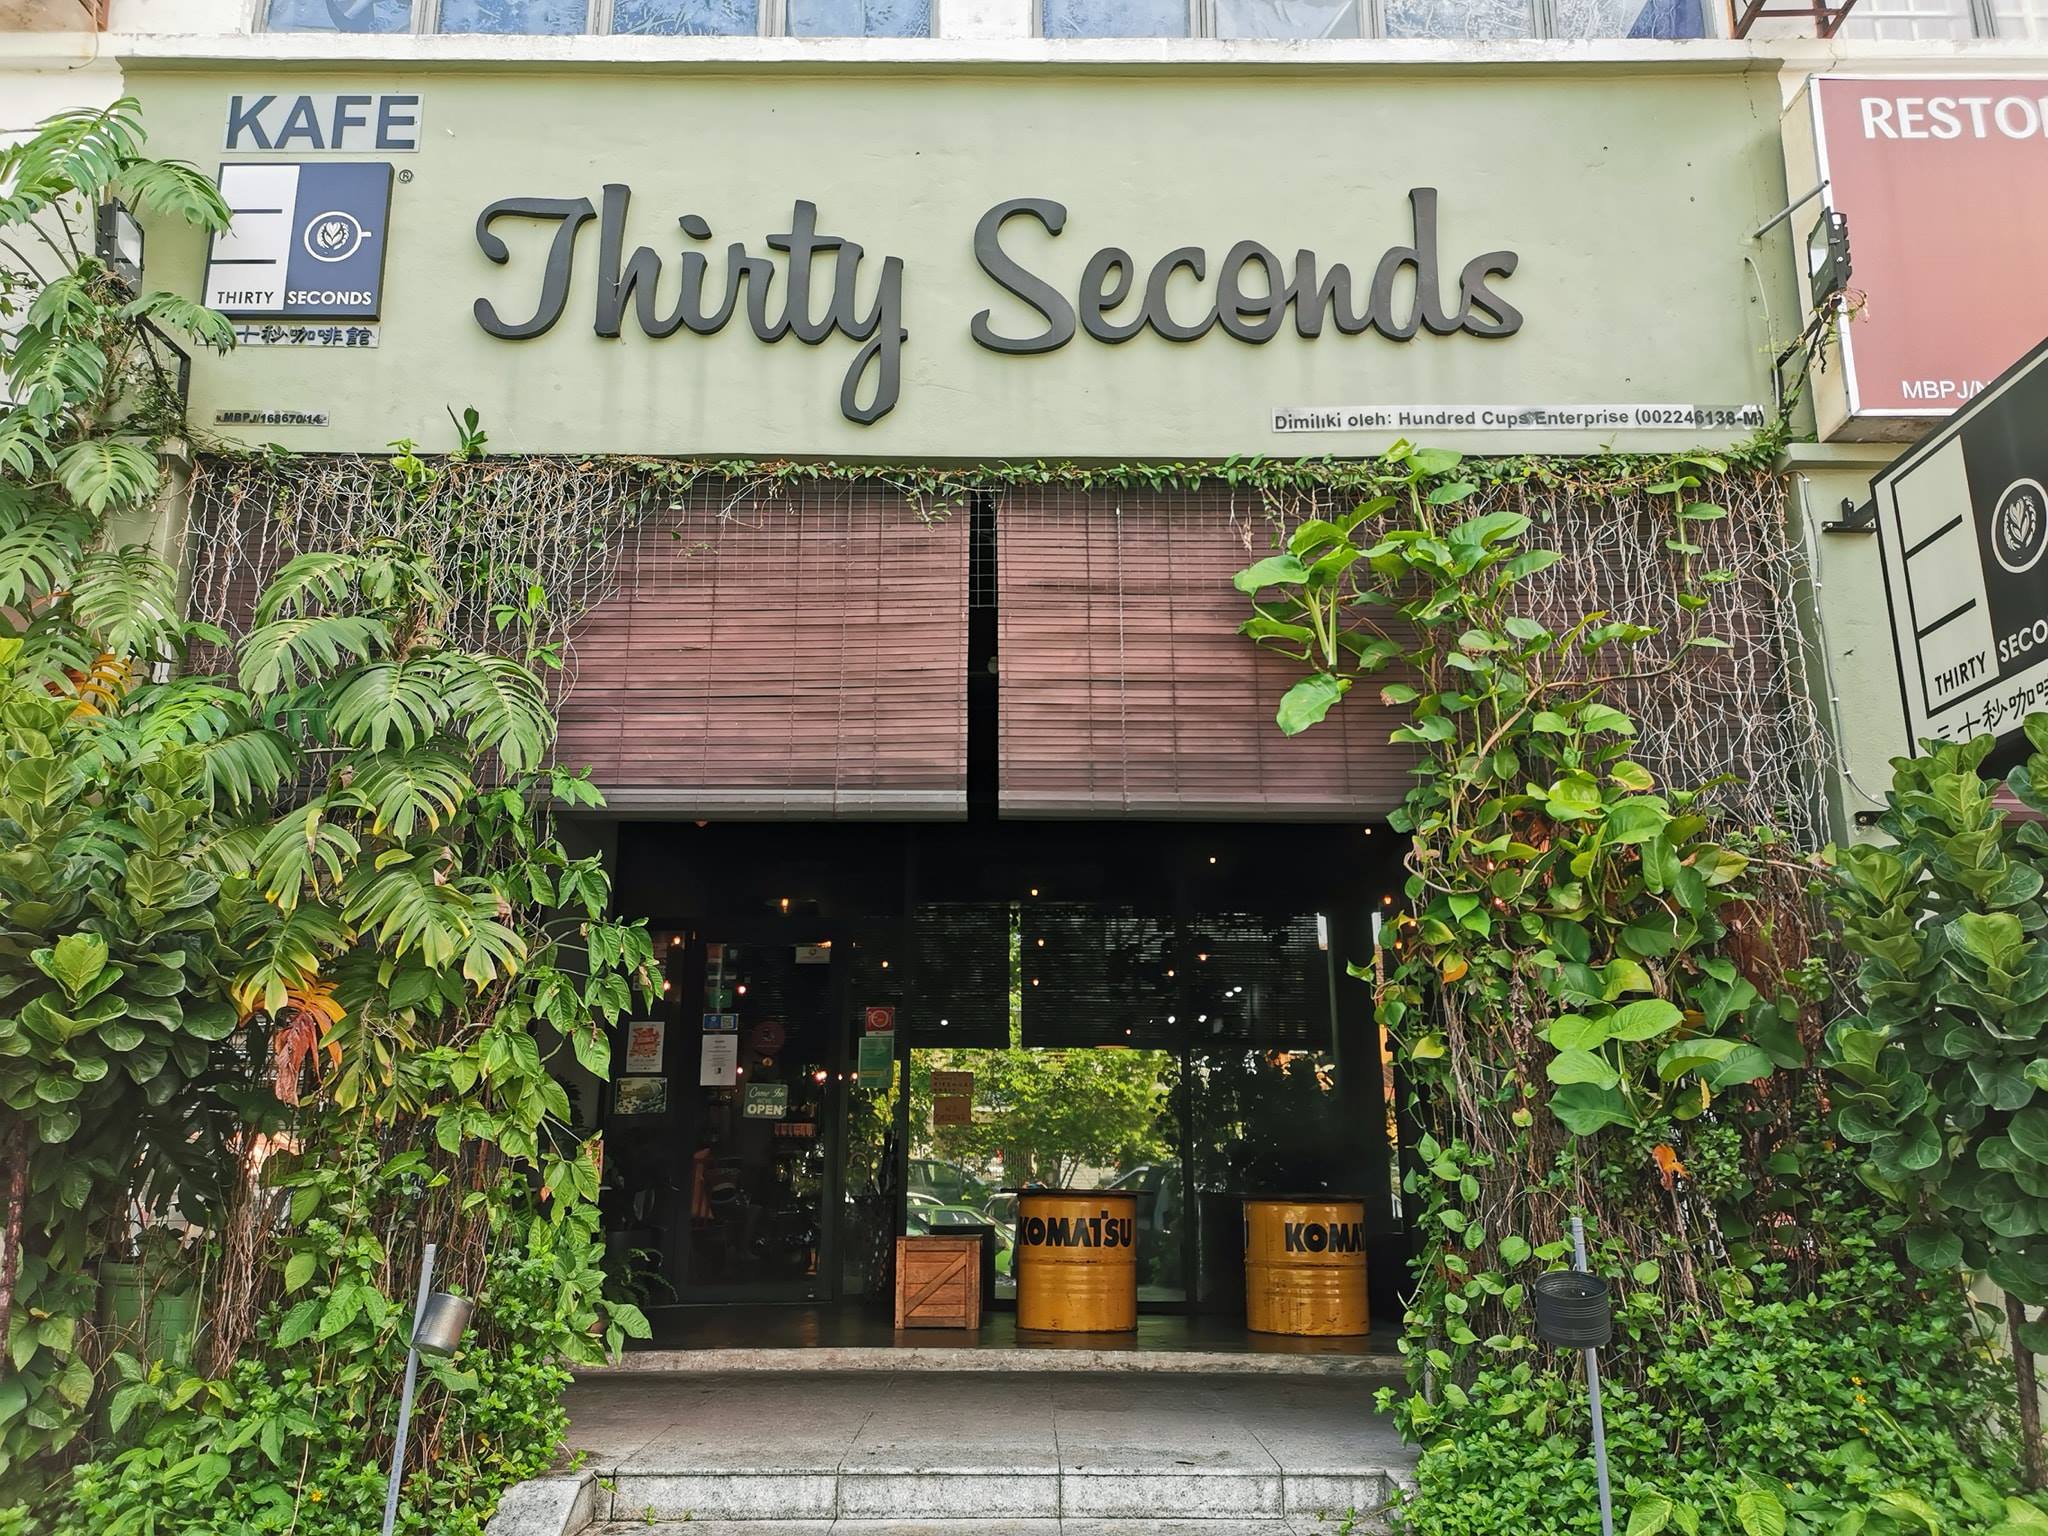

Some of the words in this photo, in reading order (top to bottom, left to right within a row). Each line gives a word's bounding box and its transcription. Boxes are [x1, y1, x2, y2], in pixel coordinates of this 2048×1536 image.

[226, 95, 419, 149] KAFE
[1861, 97, 2048, 139] RESTO
[217, 291, 274, 305] THIRTY
[287, 290, 372, 306] SECONDS
[473, 183, 908, 426] Thirty
[970, 187, 1523, 355] Seconds
[236, 325, 373, 346] 十秒咖啡館
[1275, 412, 1342, 430] Dimiliki
[1348, 412, 1392, 428] oleh:
[1399, 411, 1476, 426] Hundred
[1481, 411, 1530, 429] Cups
[1535, 409, 1629, 427] Enterprise
[1935, 651, 1985, 696] THIRTY
[1999, 619, 2048, 662] SECO
[747, 1104, 784, 1116] OPEN
[1019, 1210, 1132, 1247] KOMATSU
[1284, 1222, 1366, 1253] KOMA
